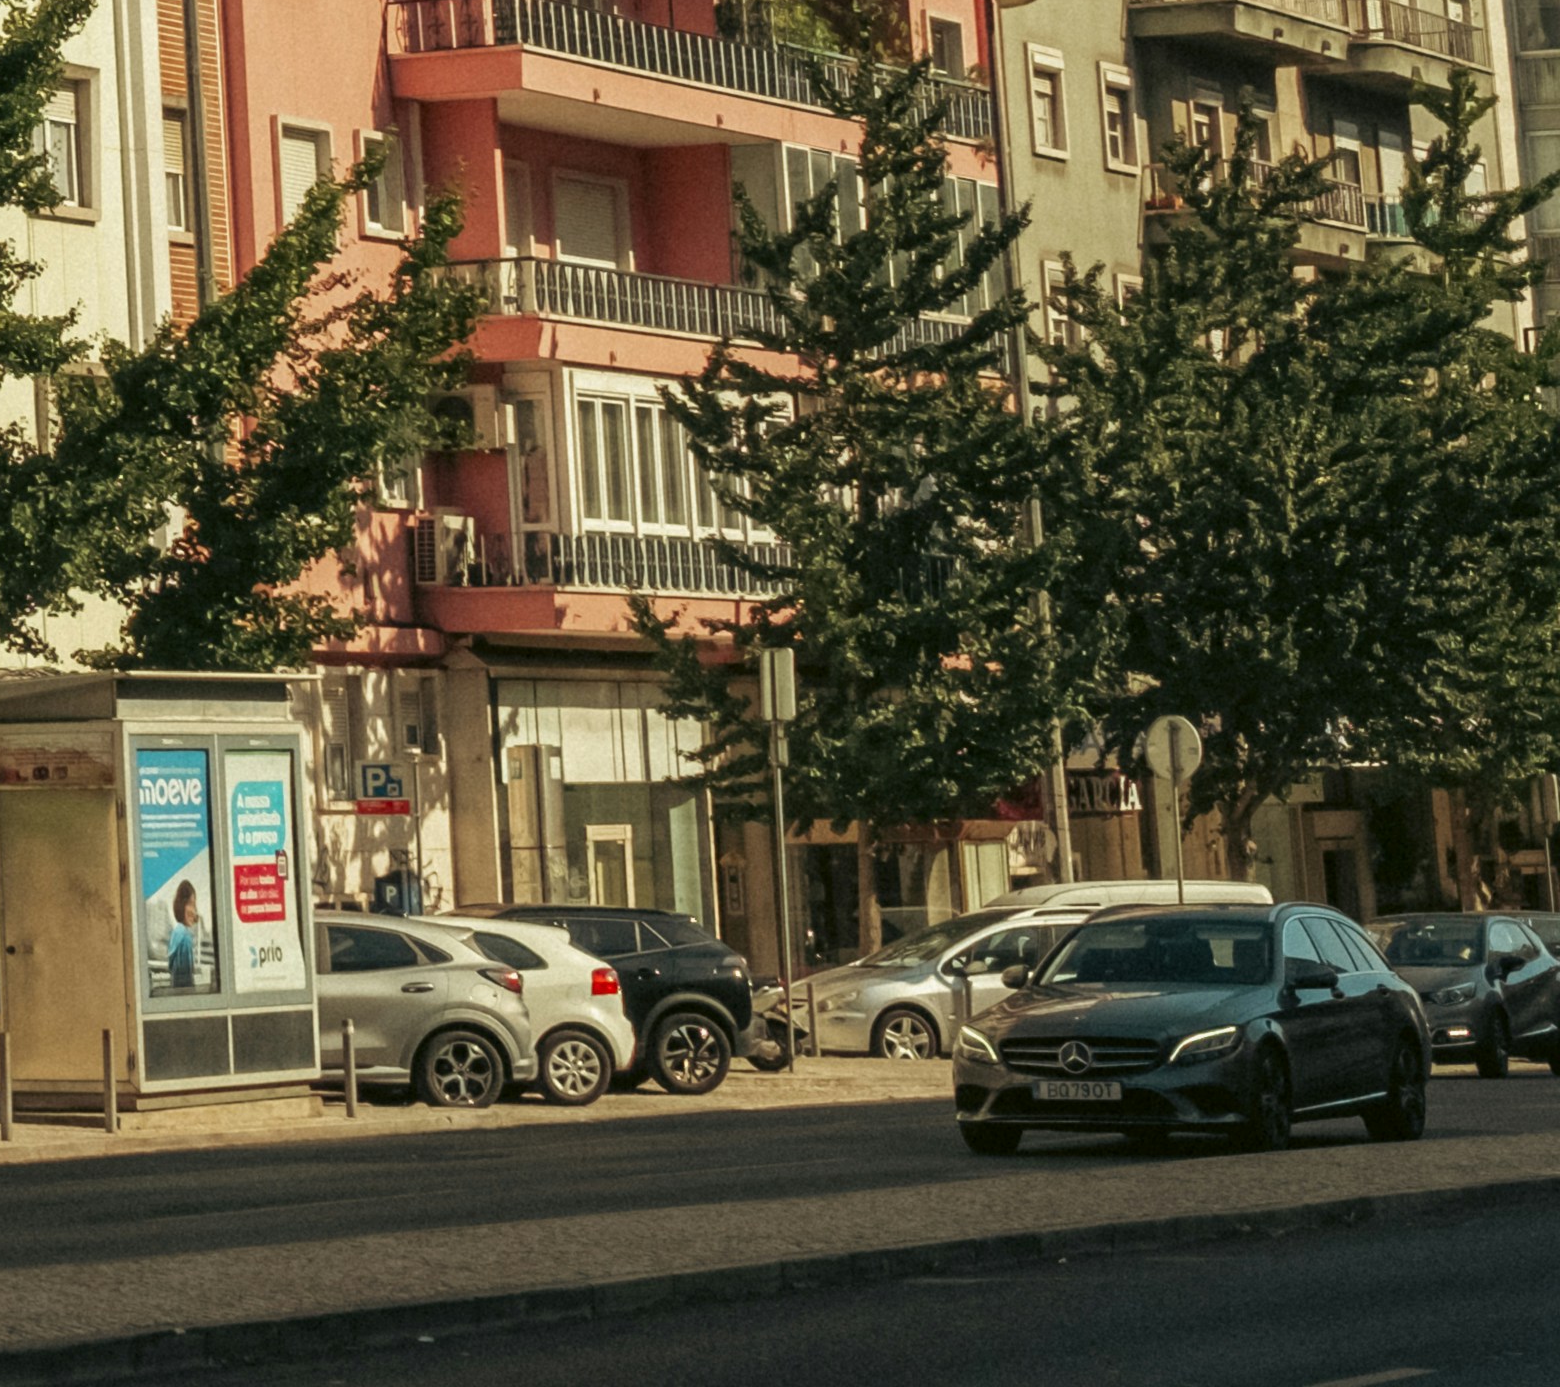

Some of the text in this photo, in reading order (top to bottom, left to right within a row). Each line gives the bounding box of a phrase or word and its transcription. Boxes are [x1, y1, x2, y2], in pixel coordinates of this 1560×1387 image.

[139, 778, 202, 806] moeve
[365, 768, 387, 796] P
[236, 793, 245, 808] A
[385, 885, 398, 904] P
[258, 940, 283, 968] prio
